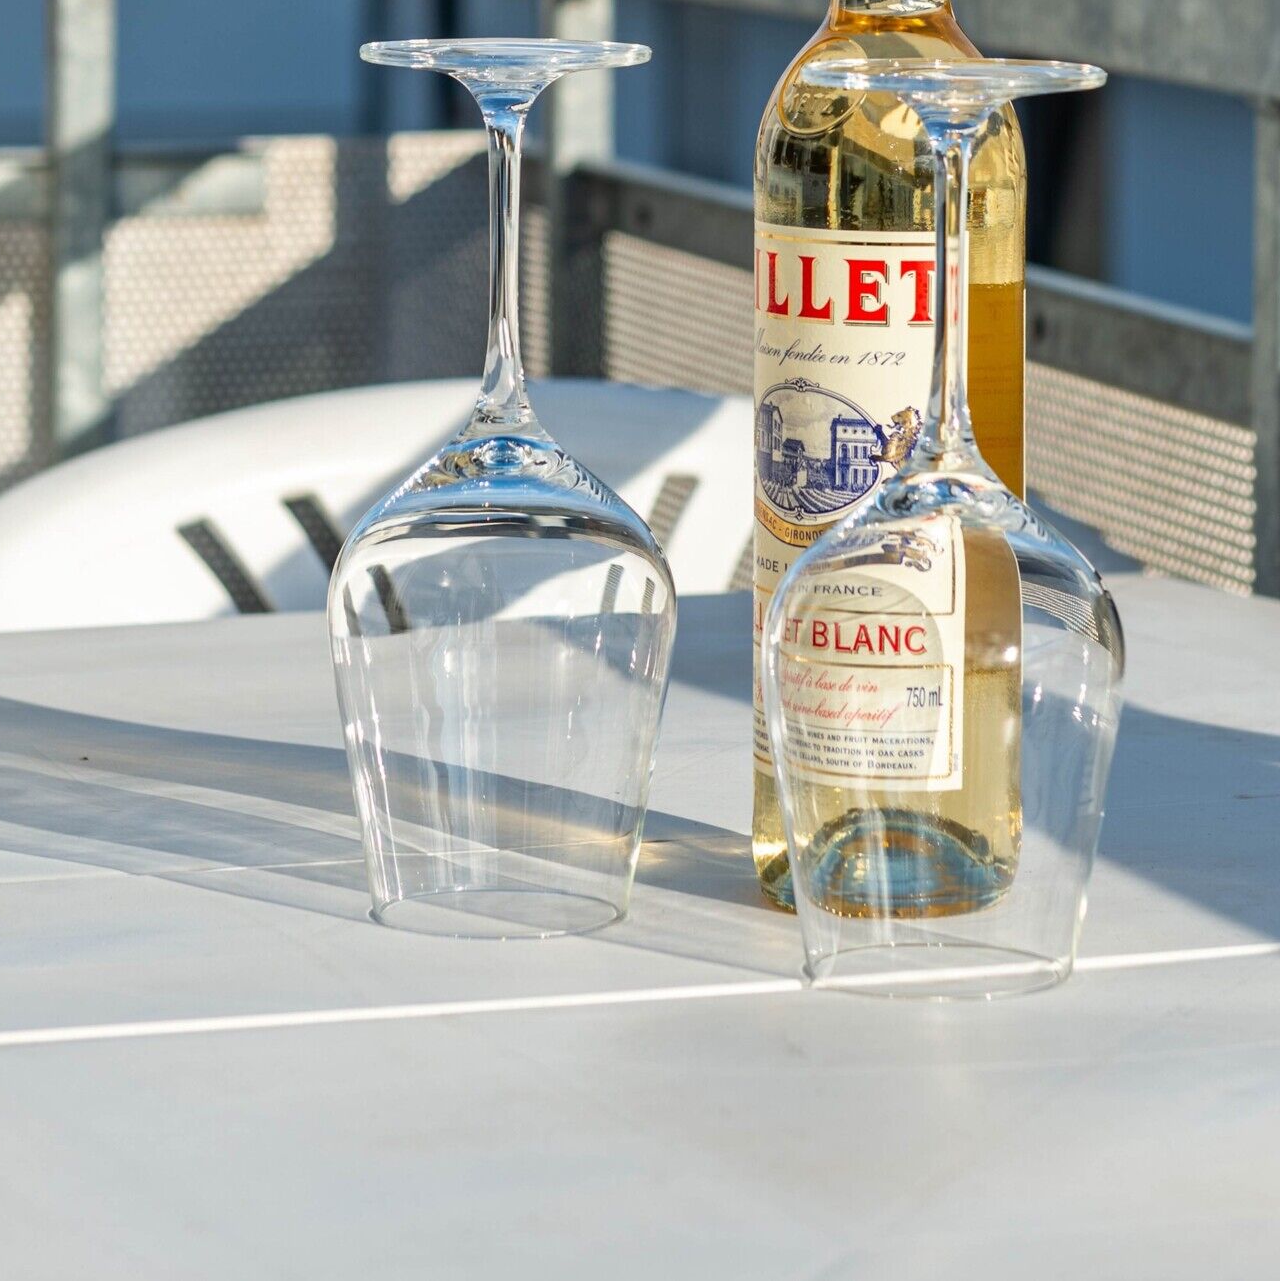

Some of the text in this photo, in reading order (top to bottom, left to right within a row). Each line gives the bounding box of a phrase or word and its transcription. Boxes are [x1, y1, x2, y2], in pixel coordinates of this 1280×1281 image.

[779, 338, 827, 366] fondée
[829, 354, 850, 364] en
[857, 351, 907, 367] 1872
[814, 584, 883, 598] FRANCE
[812, 620, 928, 656] BLANC
[838, 674, 854, 692] de
[856, 681, 879, 693] vin
[906, 685, 944, 708] 750 mL
[827, 734, 841, 742] AND
[844, 735, 868, 744] FRUIT
[872, 737, 935, 746] MACERATIONS,
[823, 745, 862, 756] TRADITION
[865, 749, 875, 757] IN
[877, 749, 895, 758] OAK
[897, 750, 925, 758] CASKS
[826, 758, 850, 767] SOUTH
